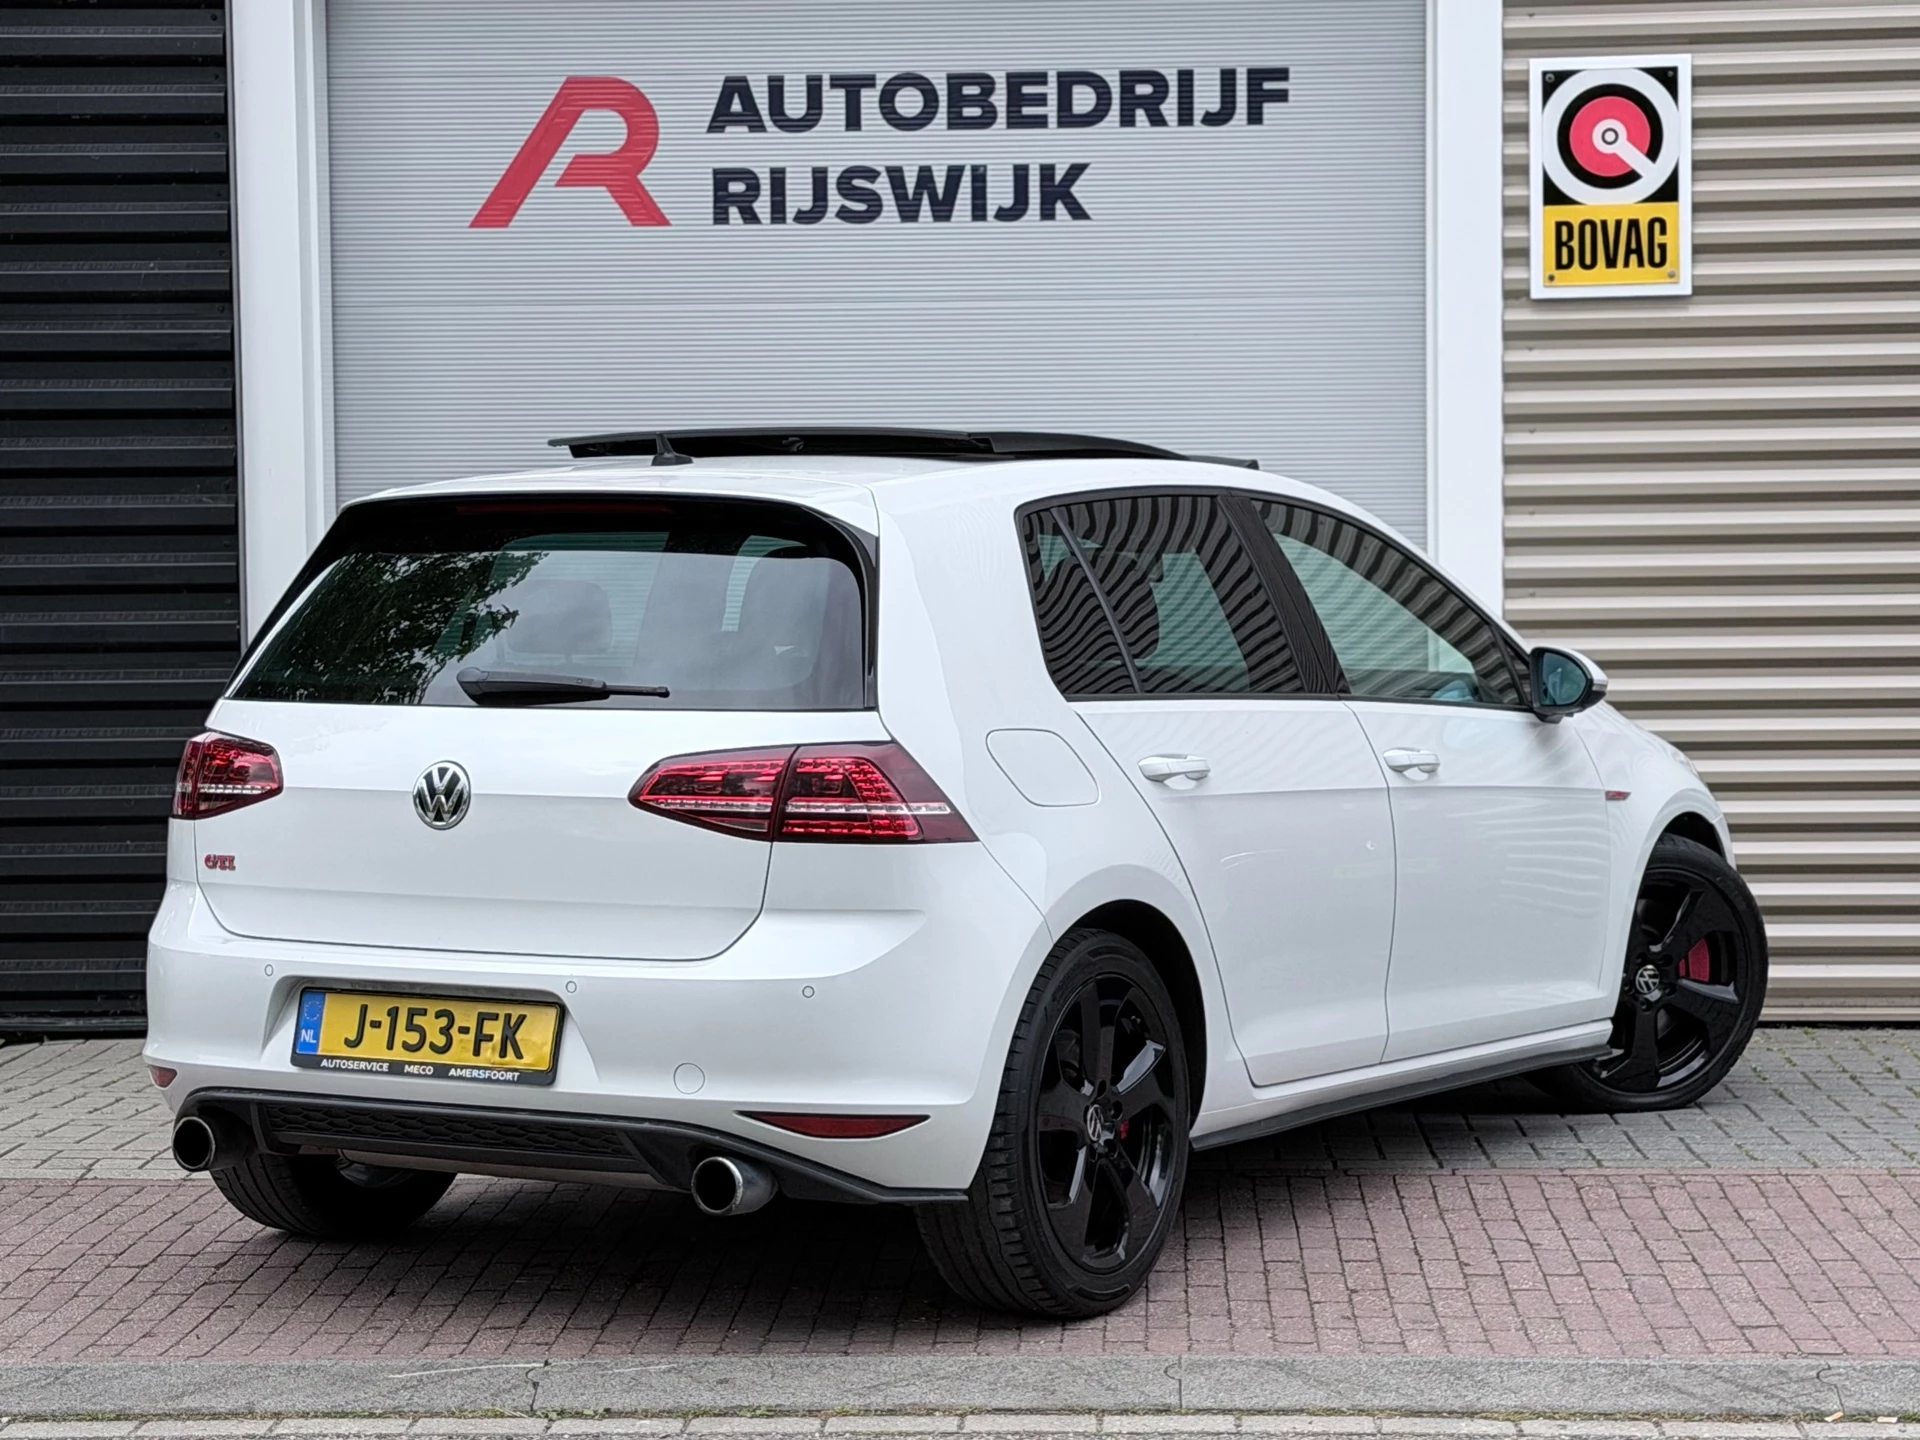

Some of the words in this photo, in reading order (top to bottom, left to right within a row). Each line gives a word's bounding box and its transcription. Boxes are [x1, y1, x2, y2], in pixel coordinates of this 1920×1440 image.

[706, 67, 1290, 133] AUTOBEDRIJF
[711, 163, 1093, 227] RIJSWIJK
[1554, 216, 1668, 271] BOVAG
[204, 853, 237, 871] GTI
[300, 1028, 317, 1044] NL
[344, 1003, 528, 1060] J-153-FK
[320, 1058, 390, 1073] AUTOSERVICE
[403, 1064, 435, 1076] MECO
[448, 1067, 521, 1082] AMERSFOORT
